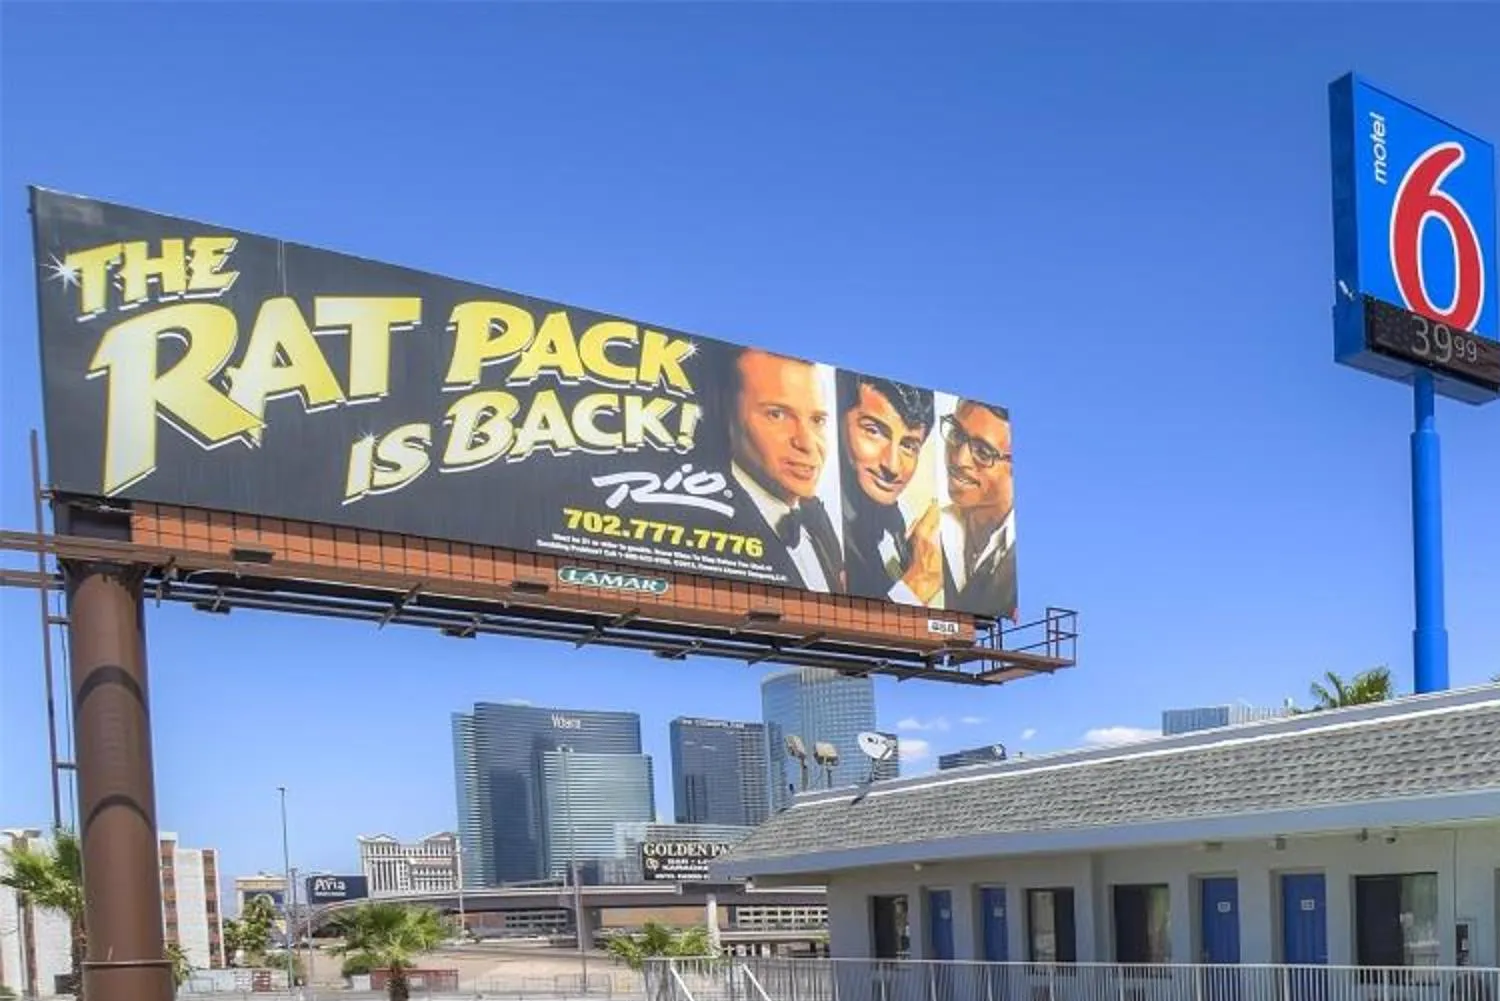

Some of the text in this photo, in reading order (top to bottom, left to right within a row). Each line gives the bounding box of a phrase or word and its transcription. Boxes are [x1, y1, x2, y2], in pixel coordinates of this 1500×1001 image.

[1370, 111, 1387, 185] motel
[1389, 141, 1485, 332] 6
[65, 236, 240, 322] THE
[86, 297, 698, 498] RAT PACK
[342, 389, 703, 505] IS BACK!
[563, 508, 764, 558] 702.777.7776
[568, 569, 658, 592] LAMAR
[643, 842, 711, 857] GOLDEN
